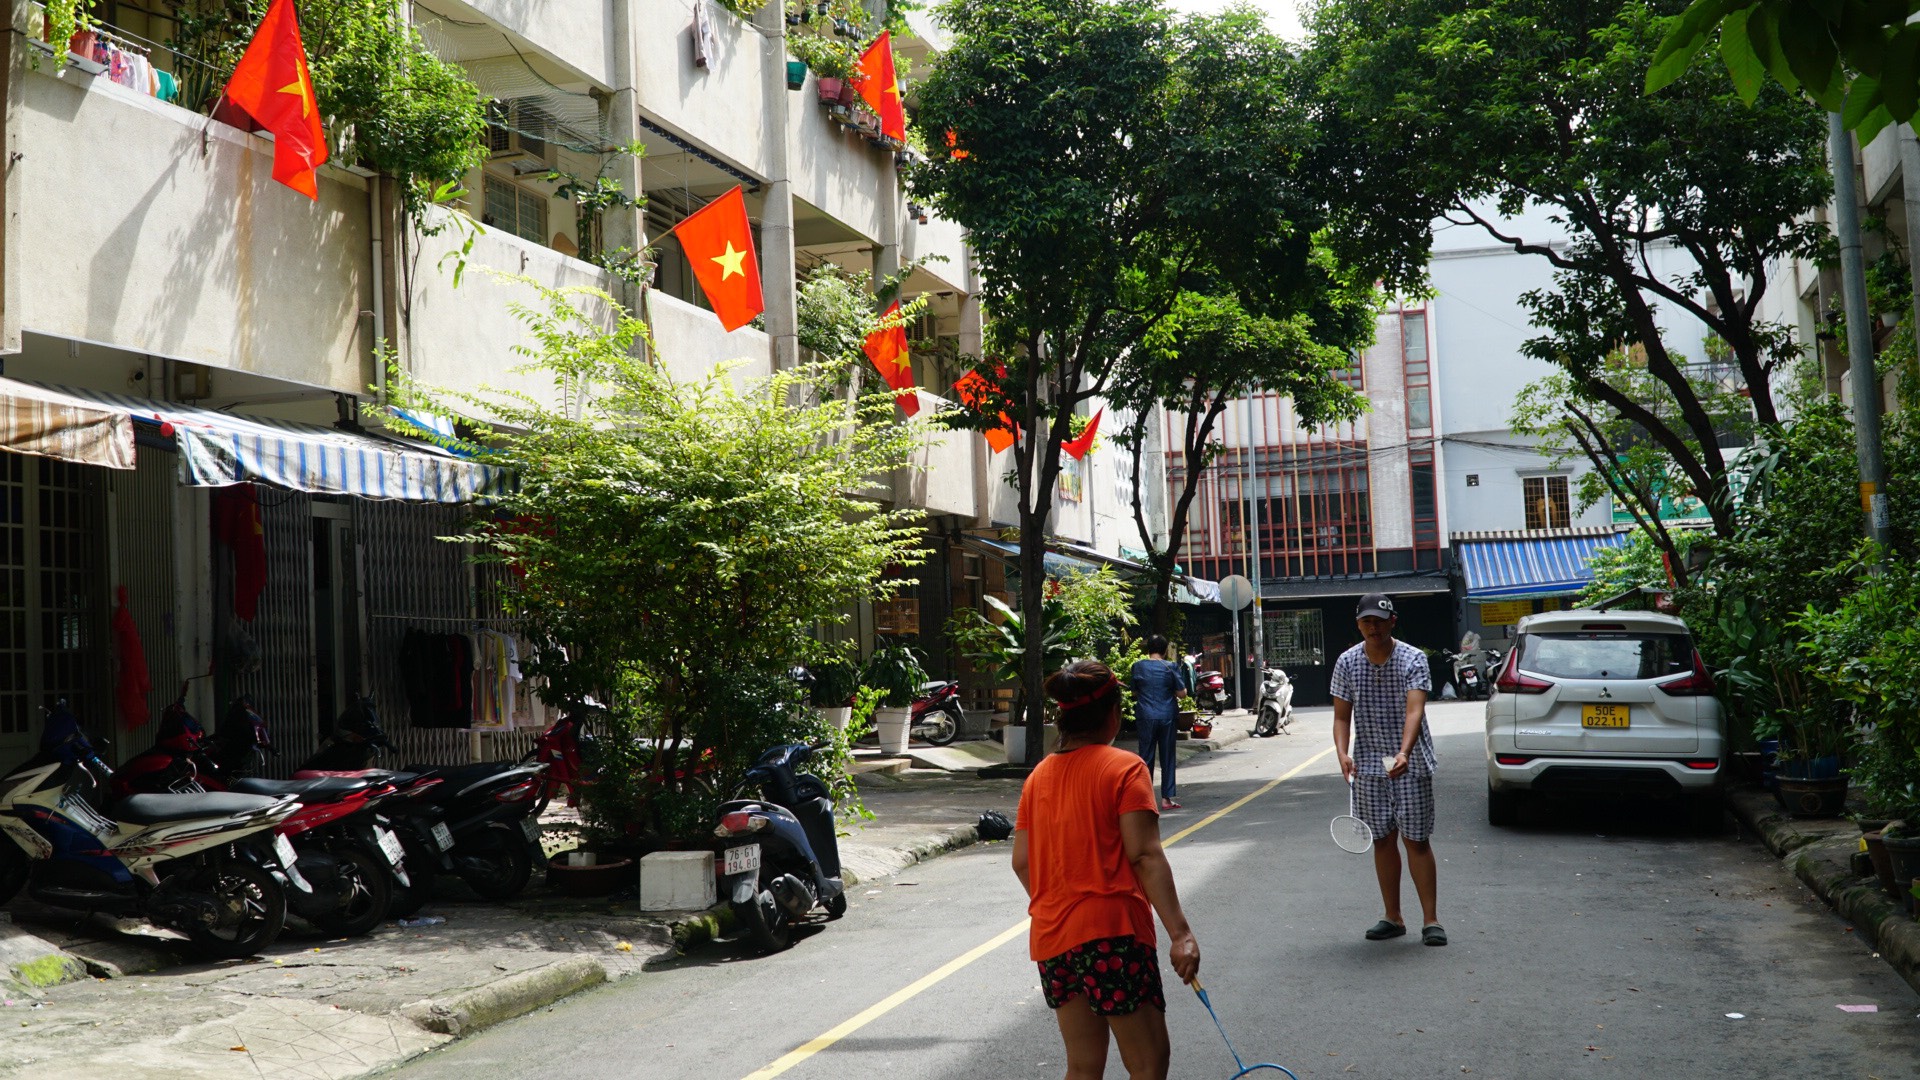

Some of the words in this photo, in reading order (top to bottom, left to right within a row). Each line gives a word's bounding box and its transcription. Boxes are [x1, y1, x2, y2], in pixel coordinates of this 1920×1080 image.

[1595, 706, 1616, 716] 50E
[1587, 716, 1624, 727] 022.11
[729, 846, 754, 861] 76-G1
[728, 857, 758, 873] 194.80
